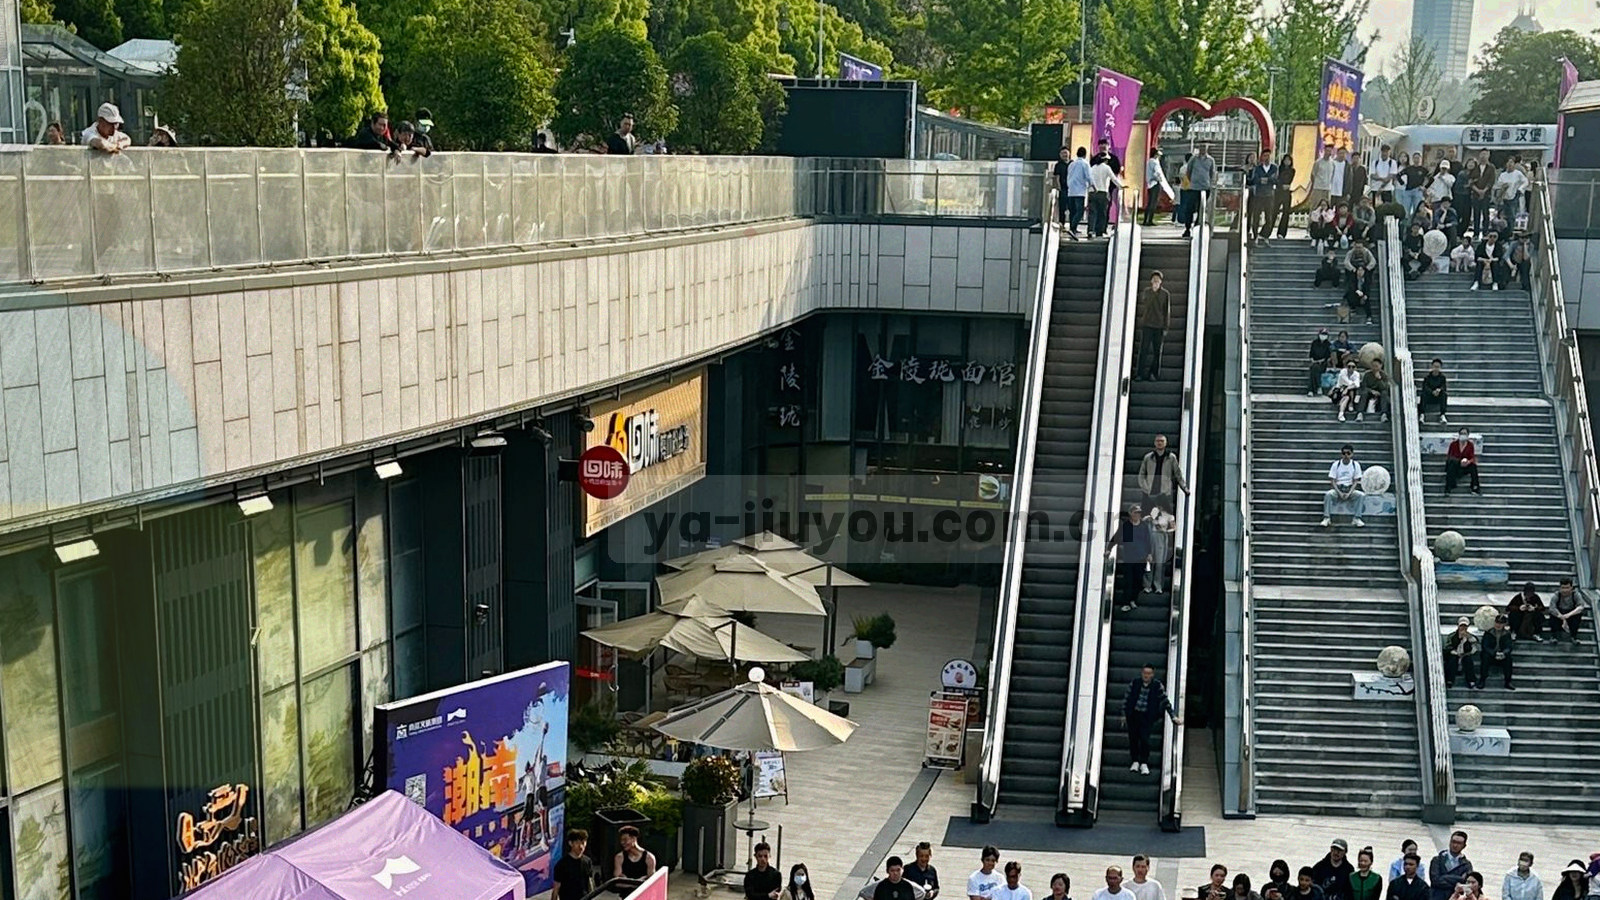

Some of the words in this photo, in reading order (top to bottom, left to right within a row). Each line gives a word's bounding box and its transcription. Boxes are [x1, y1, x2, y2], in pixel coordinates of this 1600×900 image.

[1469, 128, 1495, 142] 奇福
[1515, 128, 1542, 142] 汉堡
[582, 459, 624, 478] 回味
